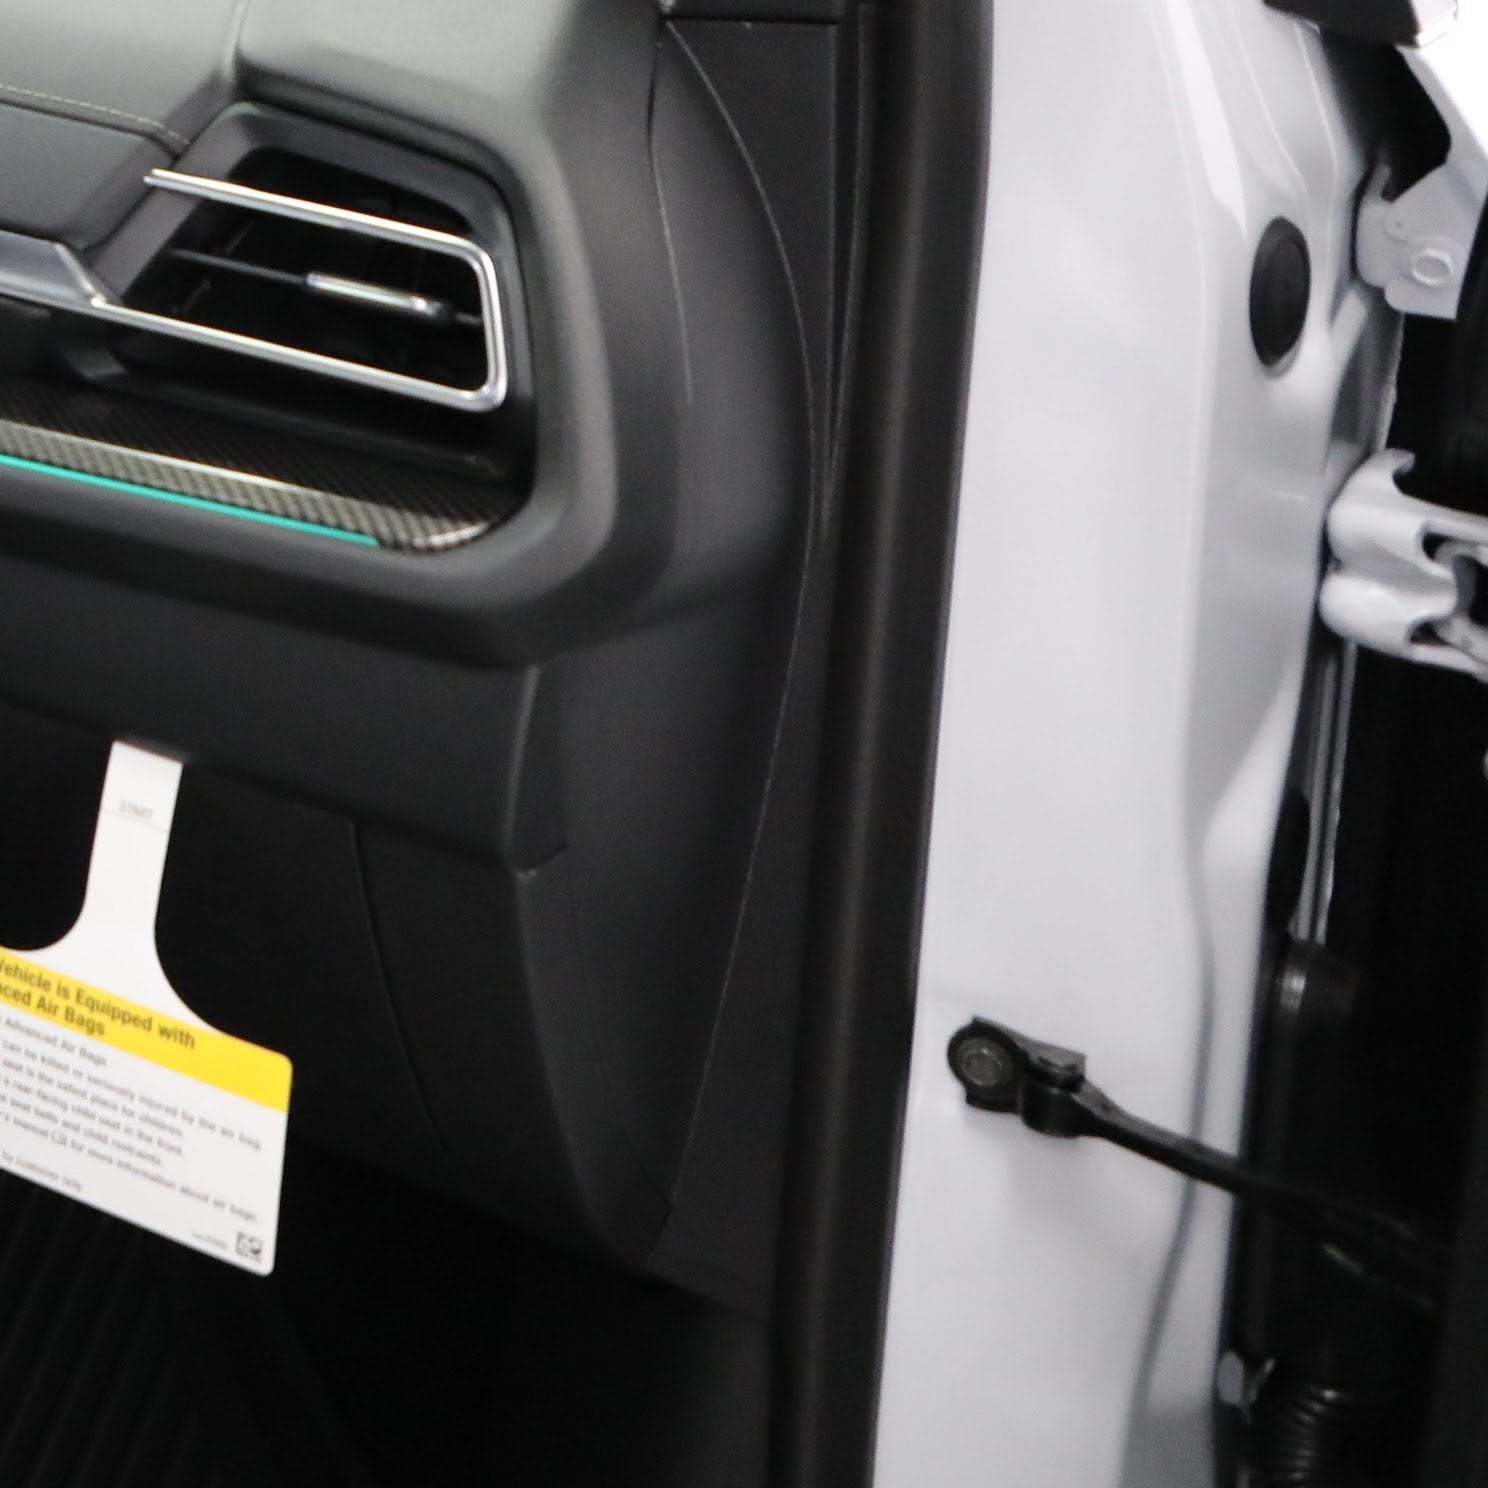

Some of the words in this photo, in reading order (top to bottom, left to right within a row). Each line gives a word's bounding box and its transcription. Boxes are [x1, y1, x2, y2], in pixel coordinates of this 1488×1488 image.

[5, 1016, 58, 1046] Advanced
[61, 1040, 76, 1052] Air
[79, 1046, 106, 1067] Bags
[36, 996, 60, 1017] Air
[64, 1006, 105, 1037] Bags
[56, 982, 70, 999] is
[76, 988, 154, 1032] Equipped
[158, 1022, 196, 1050] with
